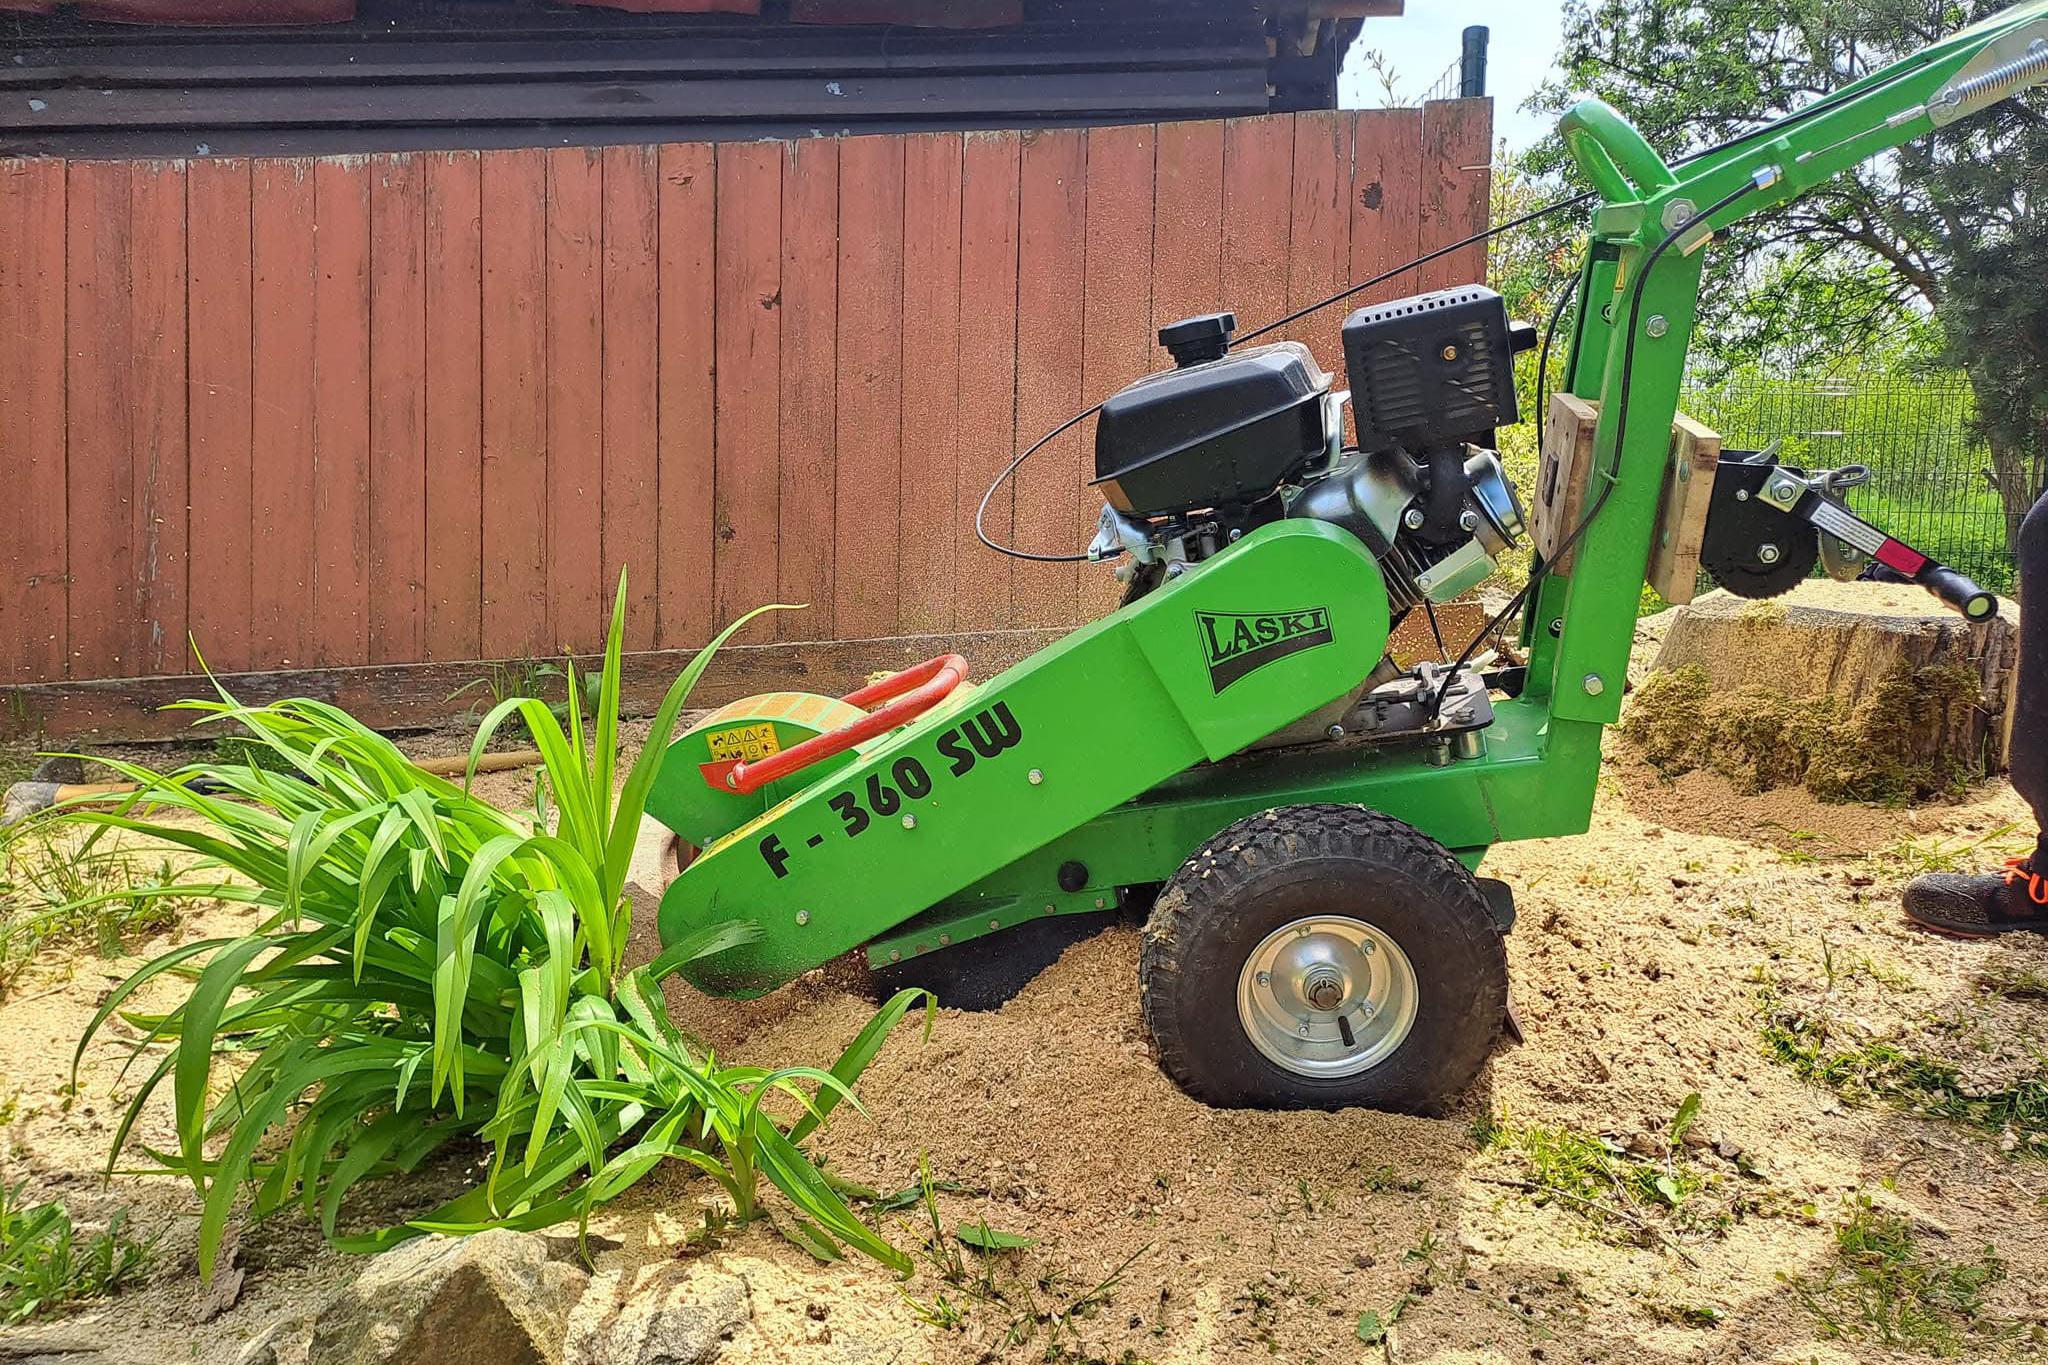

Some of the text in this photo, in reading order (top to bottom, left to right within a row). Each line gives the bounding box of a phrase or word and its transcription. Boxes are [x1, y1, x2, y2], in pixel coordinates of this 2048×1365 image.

[1201, 611, 1325, 662] LASKI
[759, 833, 790, 879] F
[827, 756, 932, 838] 360
[936, 700, 1023, 778] SW
